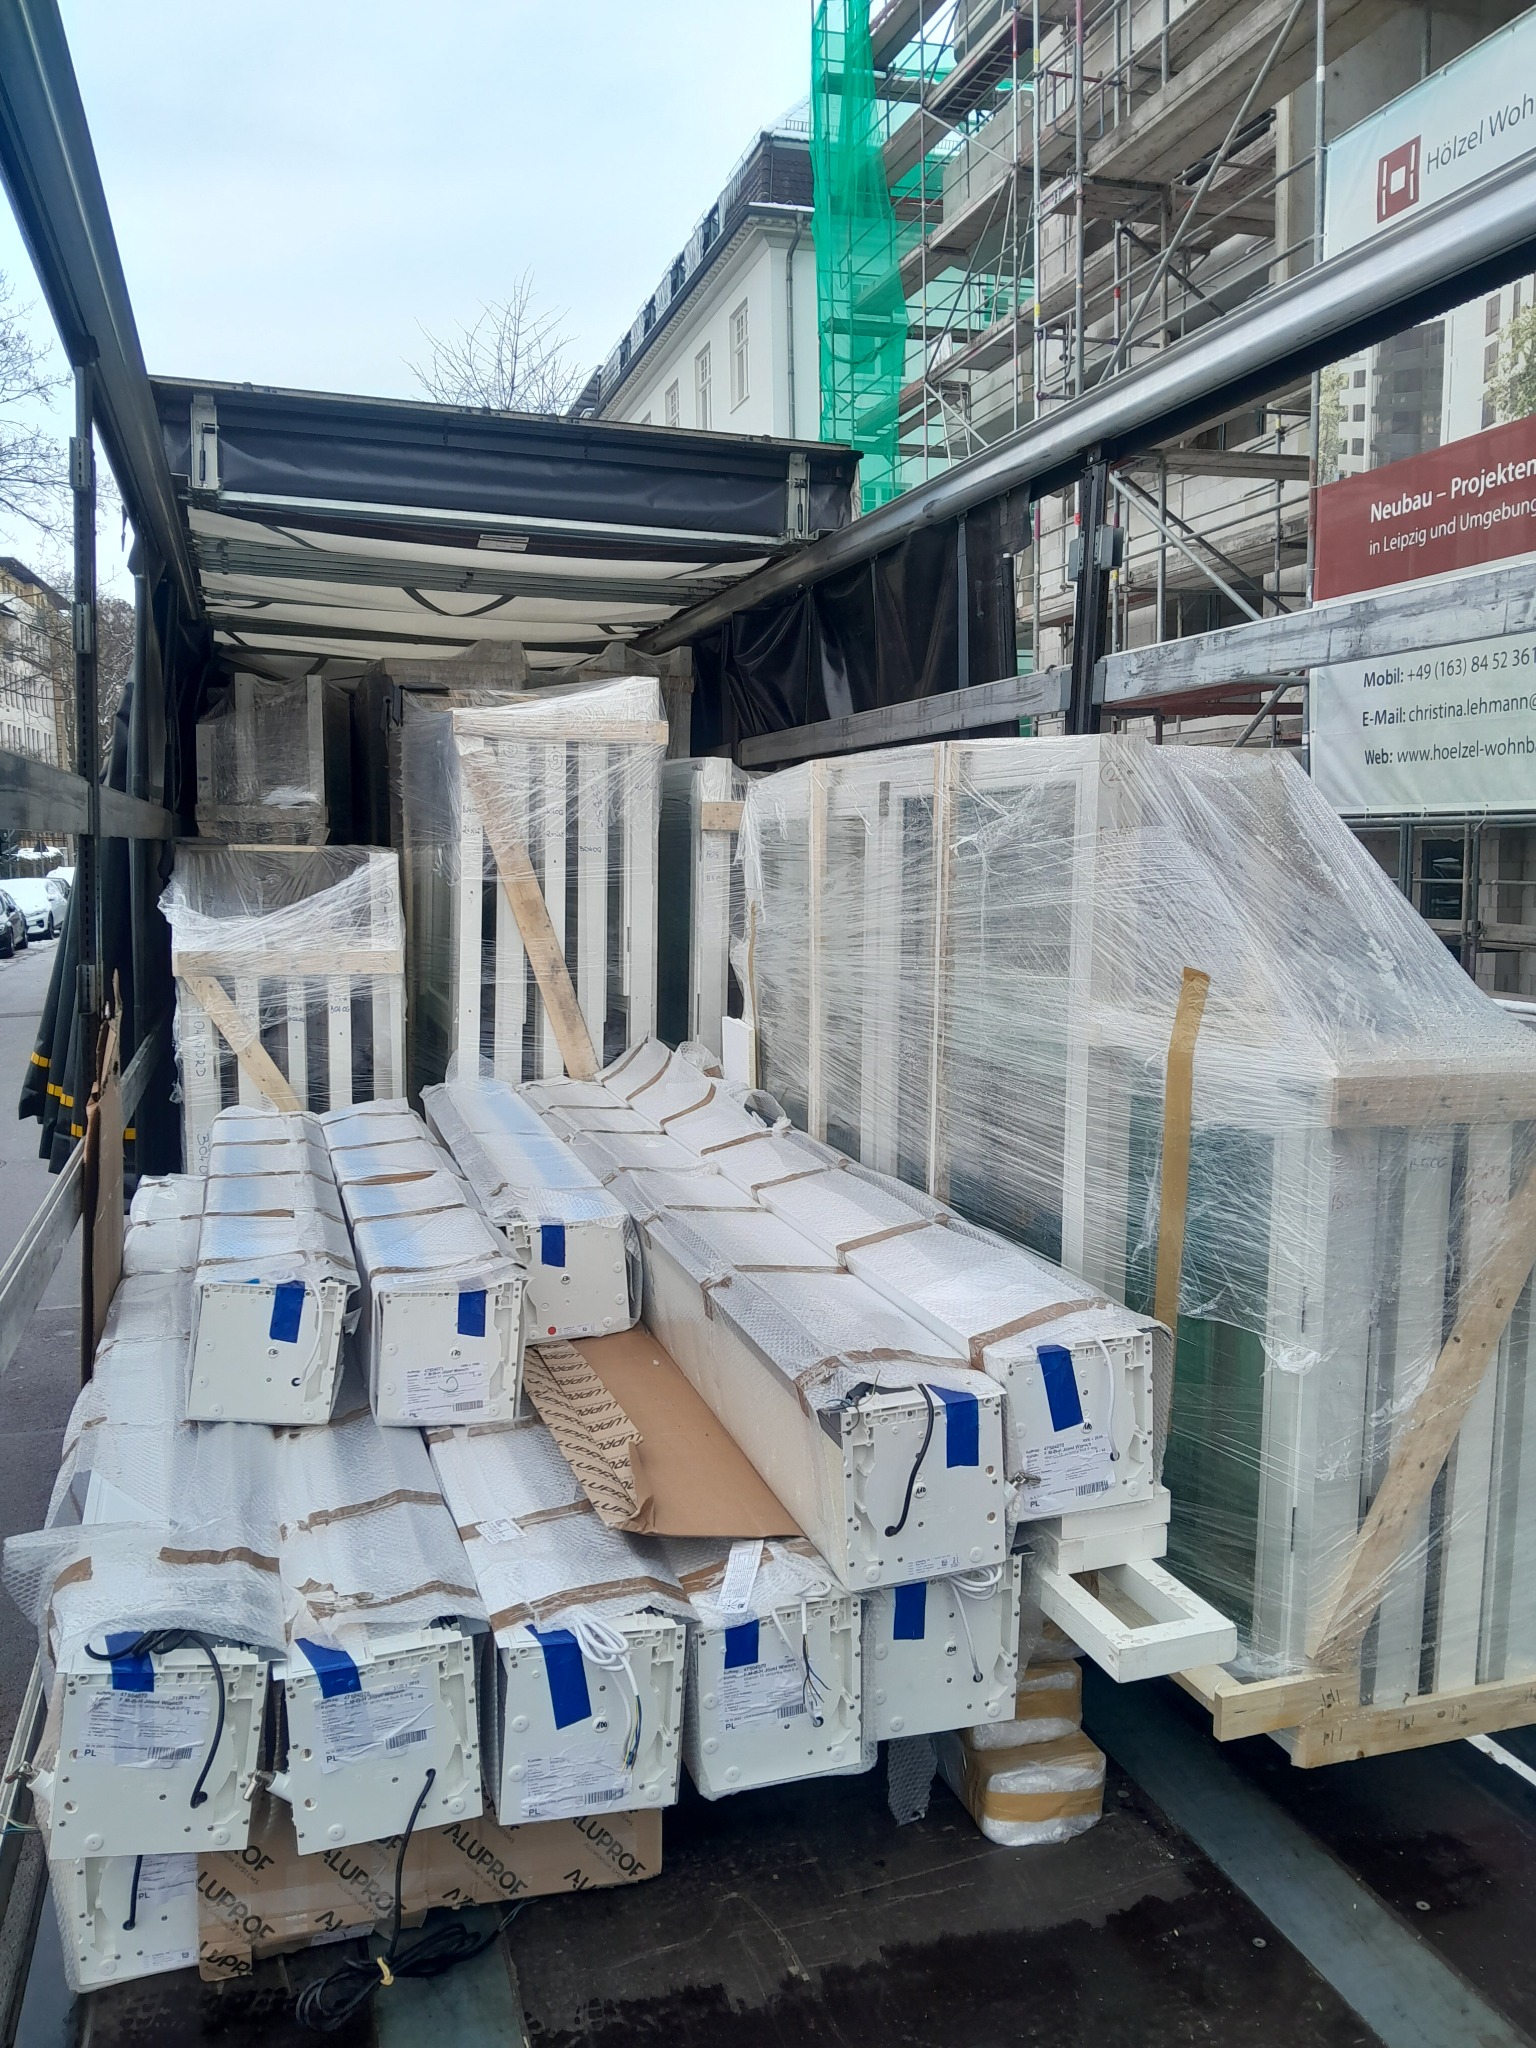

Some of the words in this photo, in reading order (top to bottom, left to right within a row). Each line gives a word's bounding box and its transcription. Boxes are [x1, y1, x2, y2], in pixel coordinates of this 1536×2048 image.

[1426, 120, 1484, 175] Hölzel
[1489, 93, 1535, 137] Woh
[1370, 491, 1433, 523] Neubau
[1369, 540, 1380, 555] in
[1383, 527, 1427, 552] Leipzig
[1430, 516, 1456, 539] und
[1363, 667, 1404, 688] Mobil:
[1407, 664, 1432, 682] +49
[1434, 657, 1467, 680] (163)
[1471, 654, 1489, 672] 84
[1493, 651, 1508, 670] 52
[1512, 648, 1530, 667] 36
[1362, 707, 1406, 727] E-Mail:
[1364, 748, 1393, 765] Web:
[1397, 735, 1536, 763] www.hoelzel-wohnb
[725, 1723, 736, 1731] PL
[84, 1748, 97, 1757] PL
[326, 1755, 339, 1763] PL
[528, 1808, 541, 1816] PL
[443, 1823, 528, 1896] ALUPROF
[572, 1816, 647, 1877] LUPROF
[138, 1892, 151, 1900] PL
